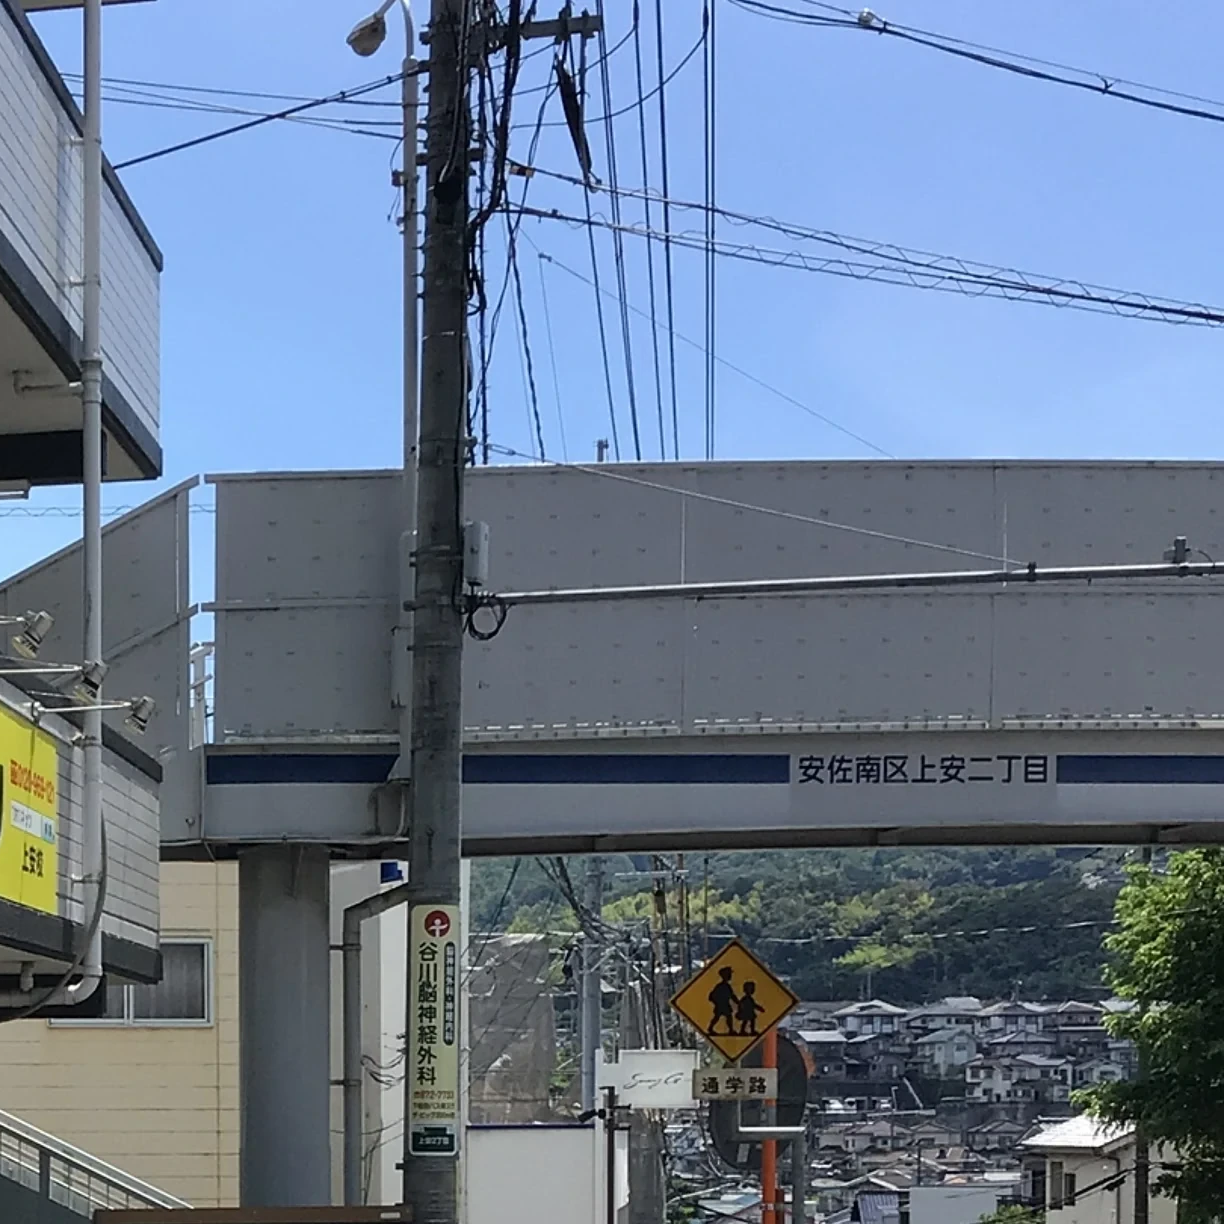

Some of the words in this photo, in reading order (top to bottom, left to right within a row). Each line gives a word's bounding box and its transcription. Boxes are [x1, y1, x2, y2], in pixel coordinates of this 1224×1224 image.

[798, 754, 1048, 784] 安佐南区上安二丁目
[417, 942, 438, 1085] 谷川脳神経外科
[701, 1076, 768, 1094] 通学路
